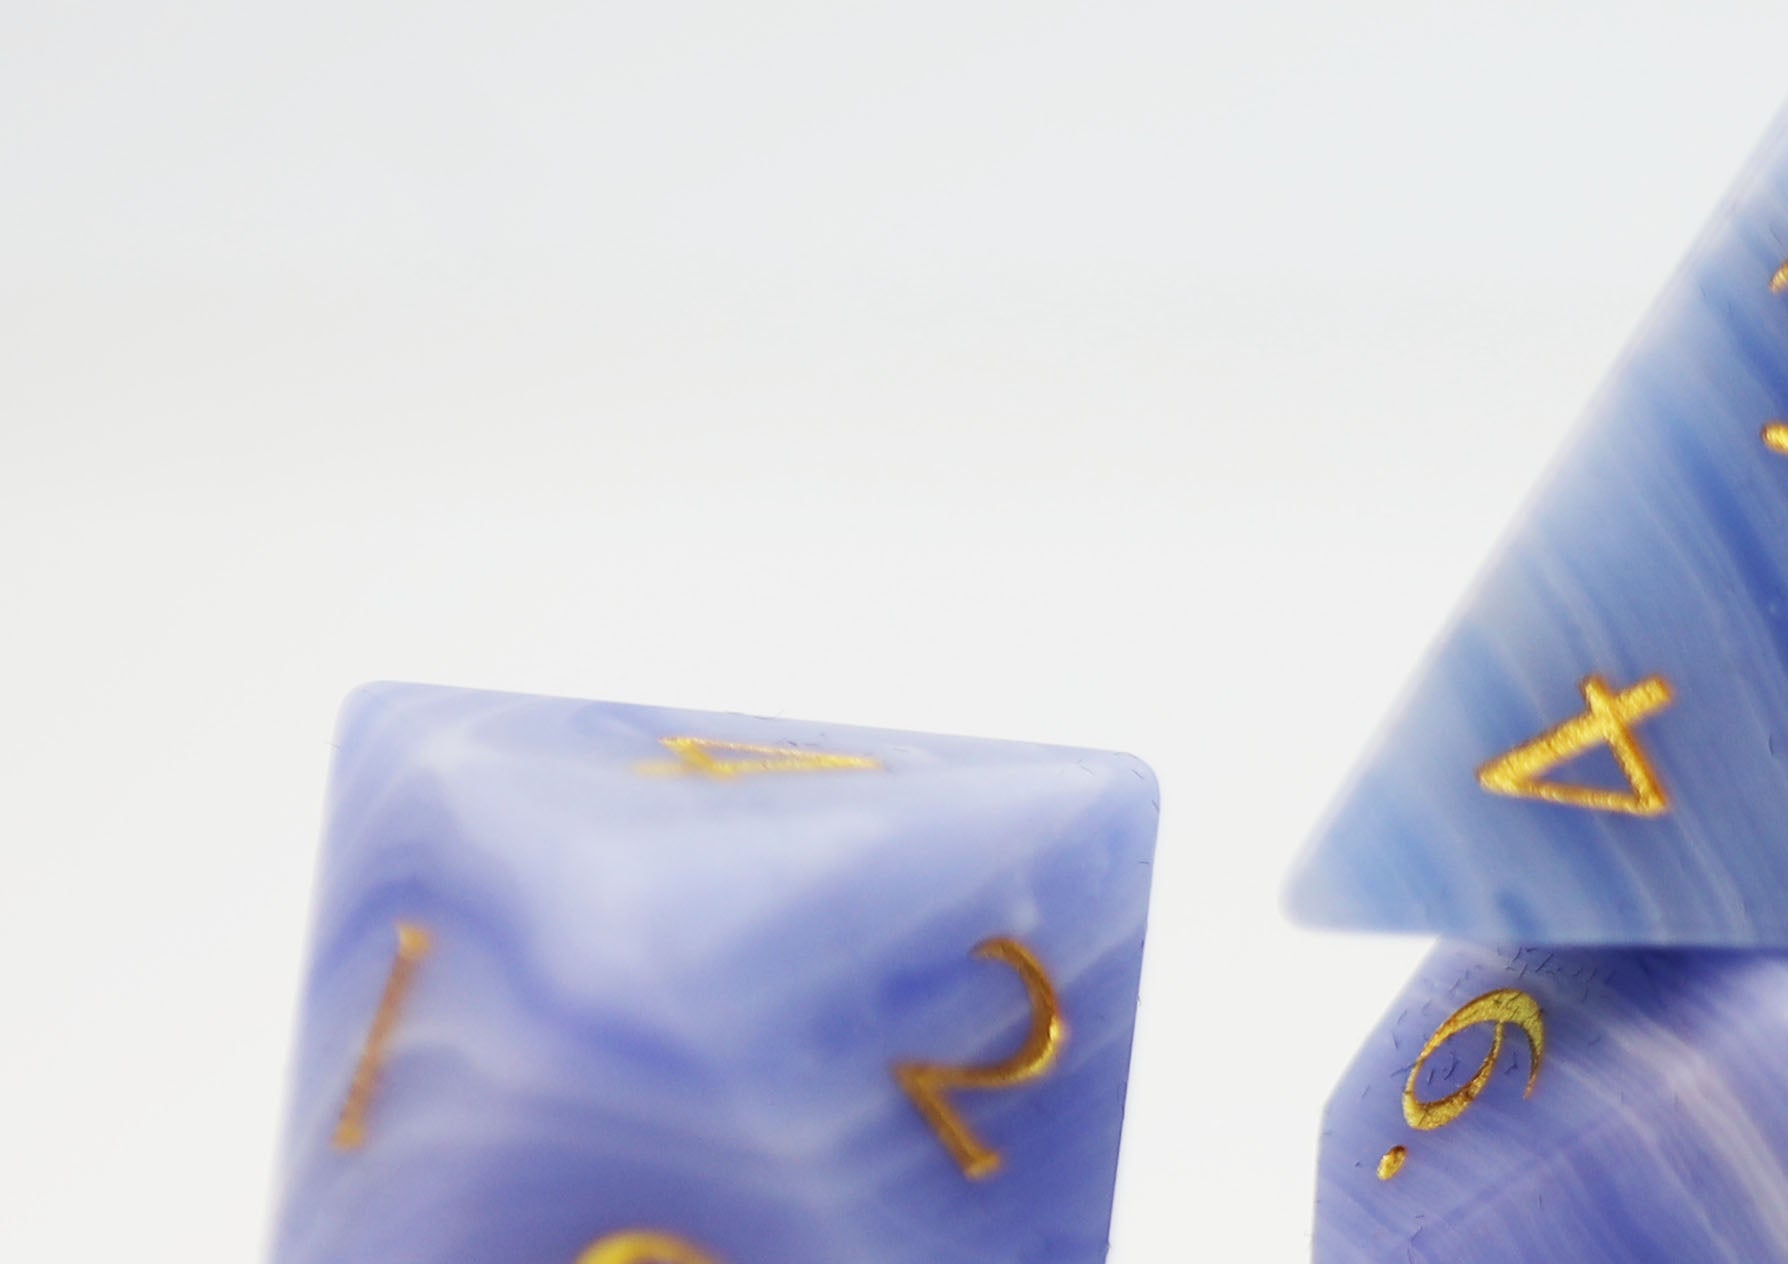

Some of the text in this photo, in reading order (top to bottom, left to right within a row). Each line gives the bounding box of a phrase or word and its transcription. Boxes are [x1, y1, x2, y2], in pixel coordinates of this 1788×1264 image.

[1474, 672, 1674, 817] 4
[331, 922, 432, 1151] 1
[894, 936, 1066, 1179] 2
